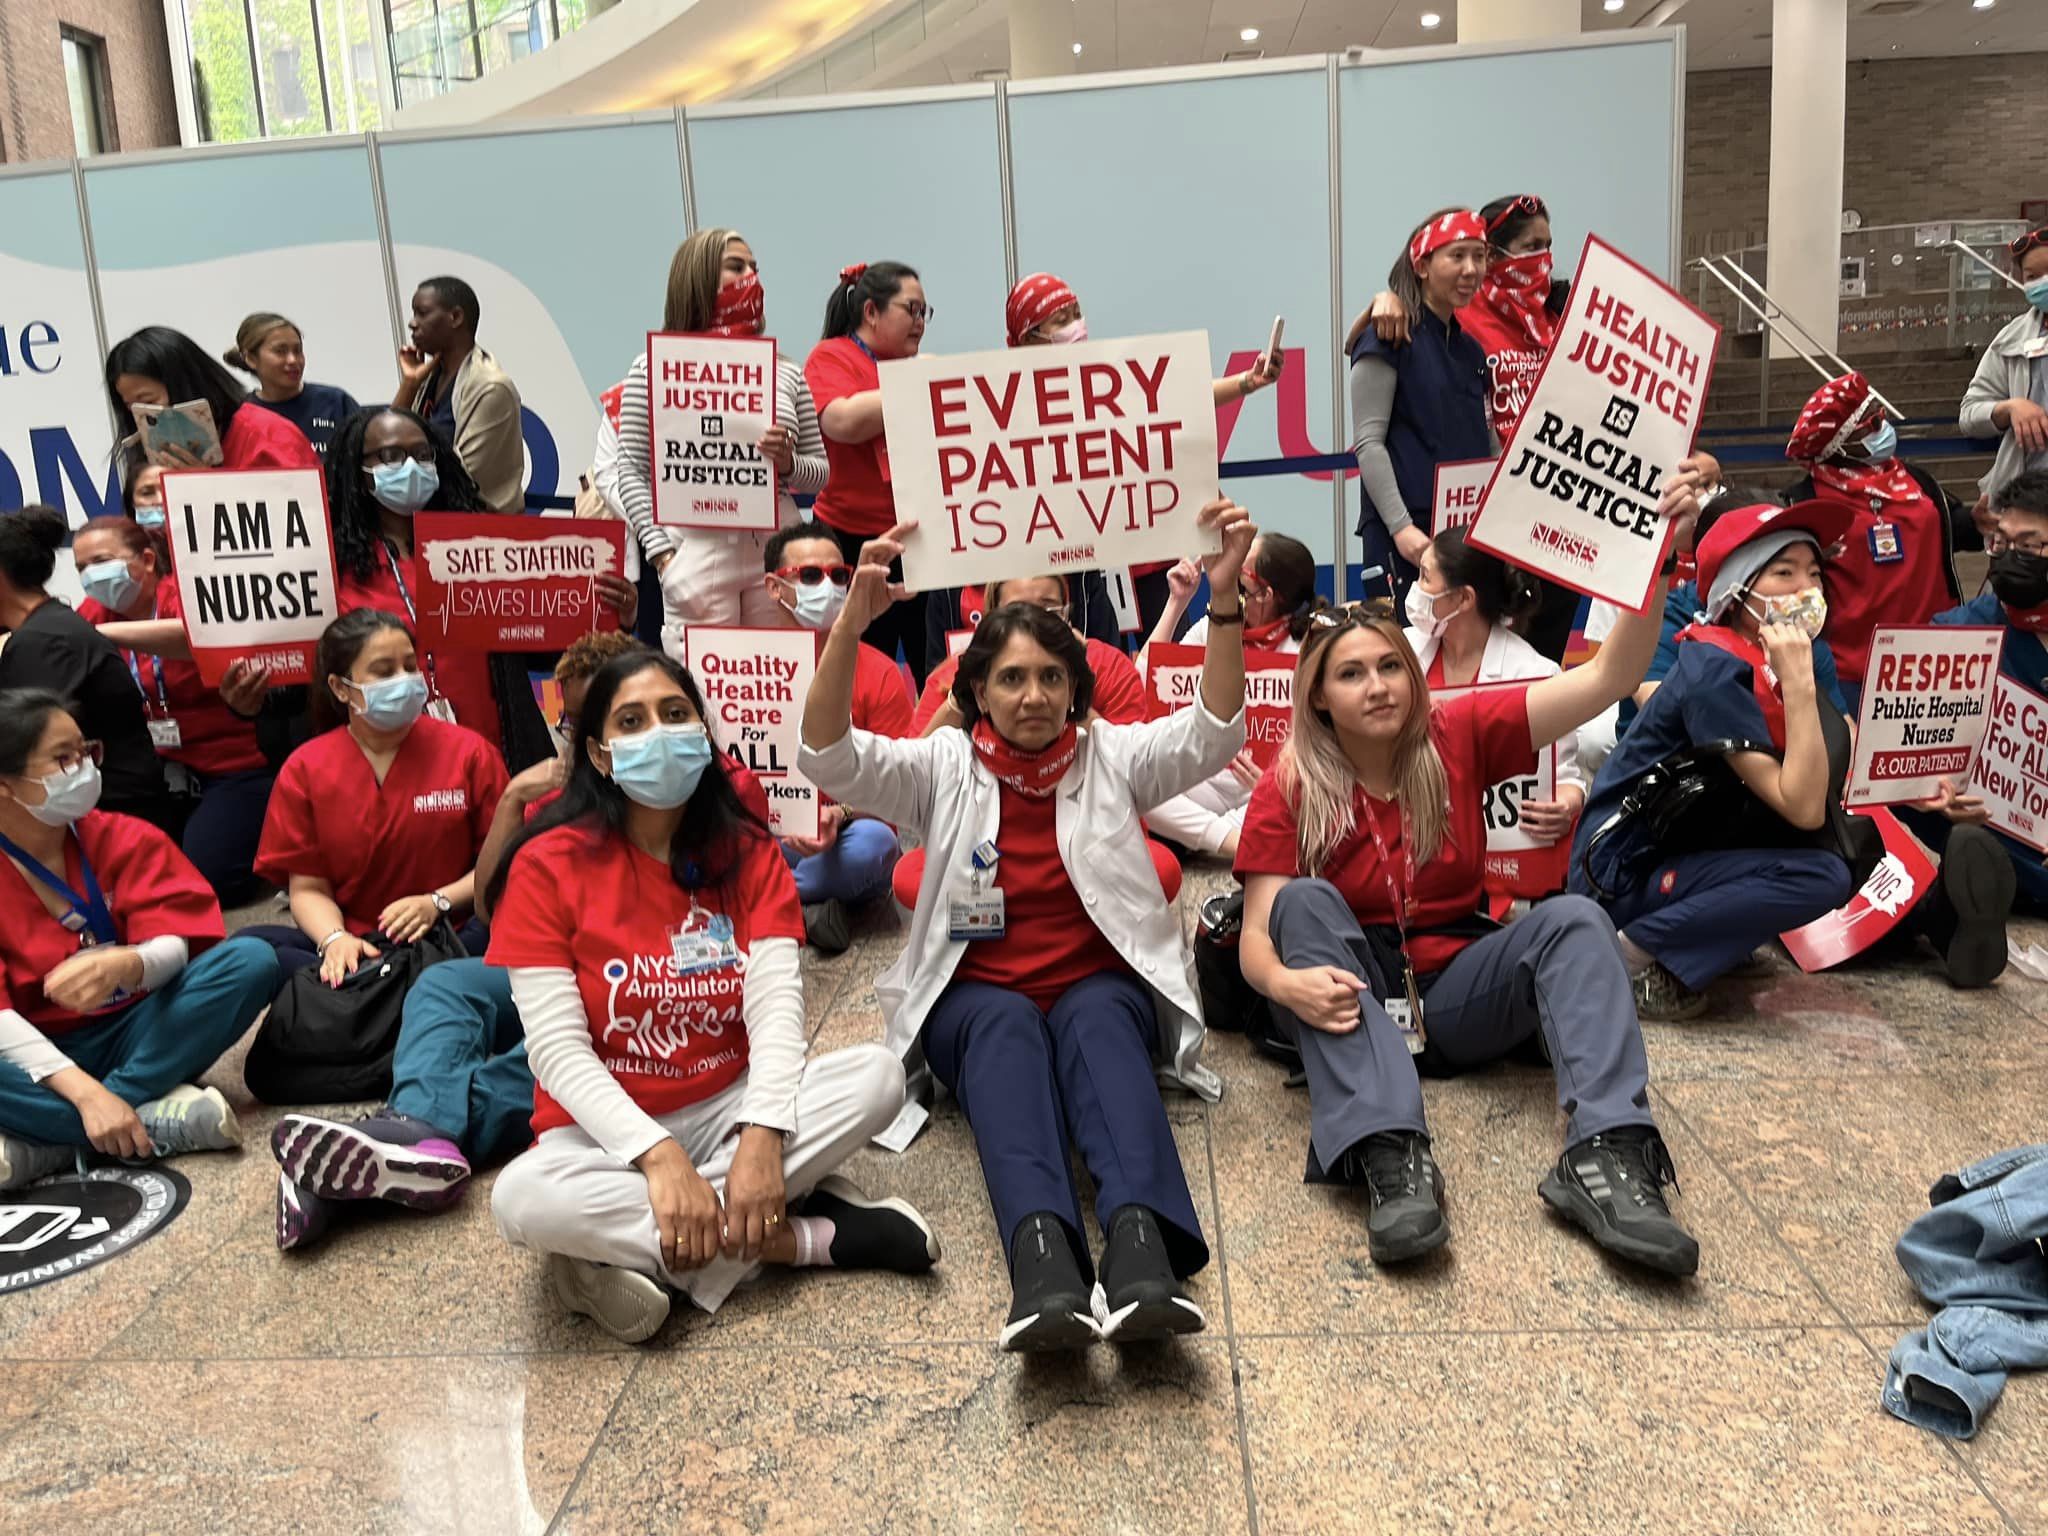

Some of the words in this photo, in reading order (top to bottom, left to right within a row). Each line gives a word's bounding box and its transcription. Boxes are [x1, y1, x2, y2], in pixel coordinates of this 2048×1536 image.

[1899, 305, 1925, 319] Desk
[1584, 285, 1700, 386] HEALTH
[662, 361, 762, 386] HEALTH
[1567, 331, 1692, 427] JUSTICE
[662, 388, 763, 413] JUSTICE
[929, 356, 1170, 438] EVERY
[1605, 402, 1635, 432] IS
[665, 440, 761, 462] RACIAL
[937, 421, 1182, 497] PATIENT
[1533, 411, 1664, 499] RACIAL
[662, 464, 767, 487] JUSTICE
[1510, 447, 1661, 540] JUSTICE
[184, 504, 198, 553] I
[213, 501, 272, 552] AM
[286, 500, 311, 548] A
[945, 500, 1007, 553] IS
[1025, 494, 1064, 544] A
[1077, 479, 1180, 536] VIP
[1530, 522, 1599, 563] NURSES
[446, 547, 496, 574] SAFE
[504, 544, 595, 572] STAFFING
[194, 570, 323, 624] NURSE
[460, 588, 525, 617] SAVES
[530, 588, 580, 617] LIVES
[701, 653, 798, 682] Quality
[1876, 653, 1992, 692] RESPECT
[705, 679, 793, 702] Health
[720, 703, 782, 725] Care
[1872, 696, 1925, 720] Public
[1927, 694, 1984, 724] Hospital
[740, 727, 768, 742] For
[1246, 716, 1288, 743] IVES
[1901, 723, 1954, 746] Nurses
[2021, 704, 2048, 746] Ca
[1988, 721, 2021, 763] For
[726, 743, 788, 772] ALL
[1876, 757, 1886, 776] &
[1888, 756, 1919, 773] OUR
[1918, 752, 1966, 772] PATIENTS
[1973, 757, 2018, 803] New
[656, 998, 708, 1016] Care
[605, 1057, 684, 1078] BELLEVUE
